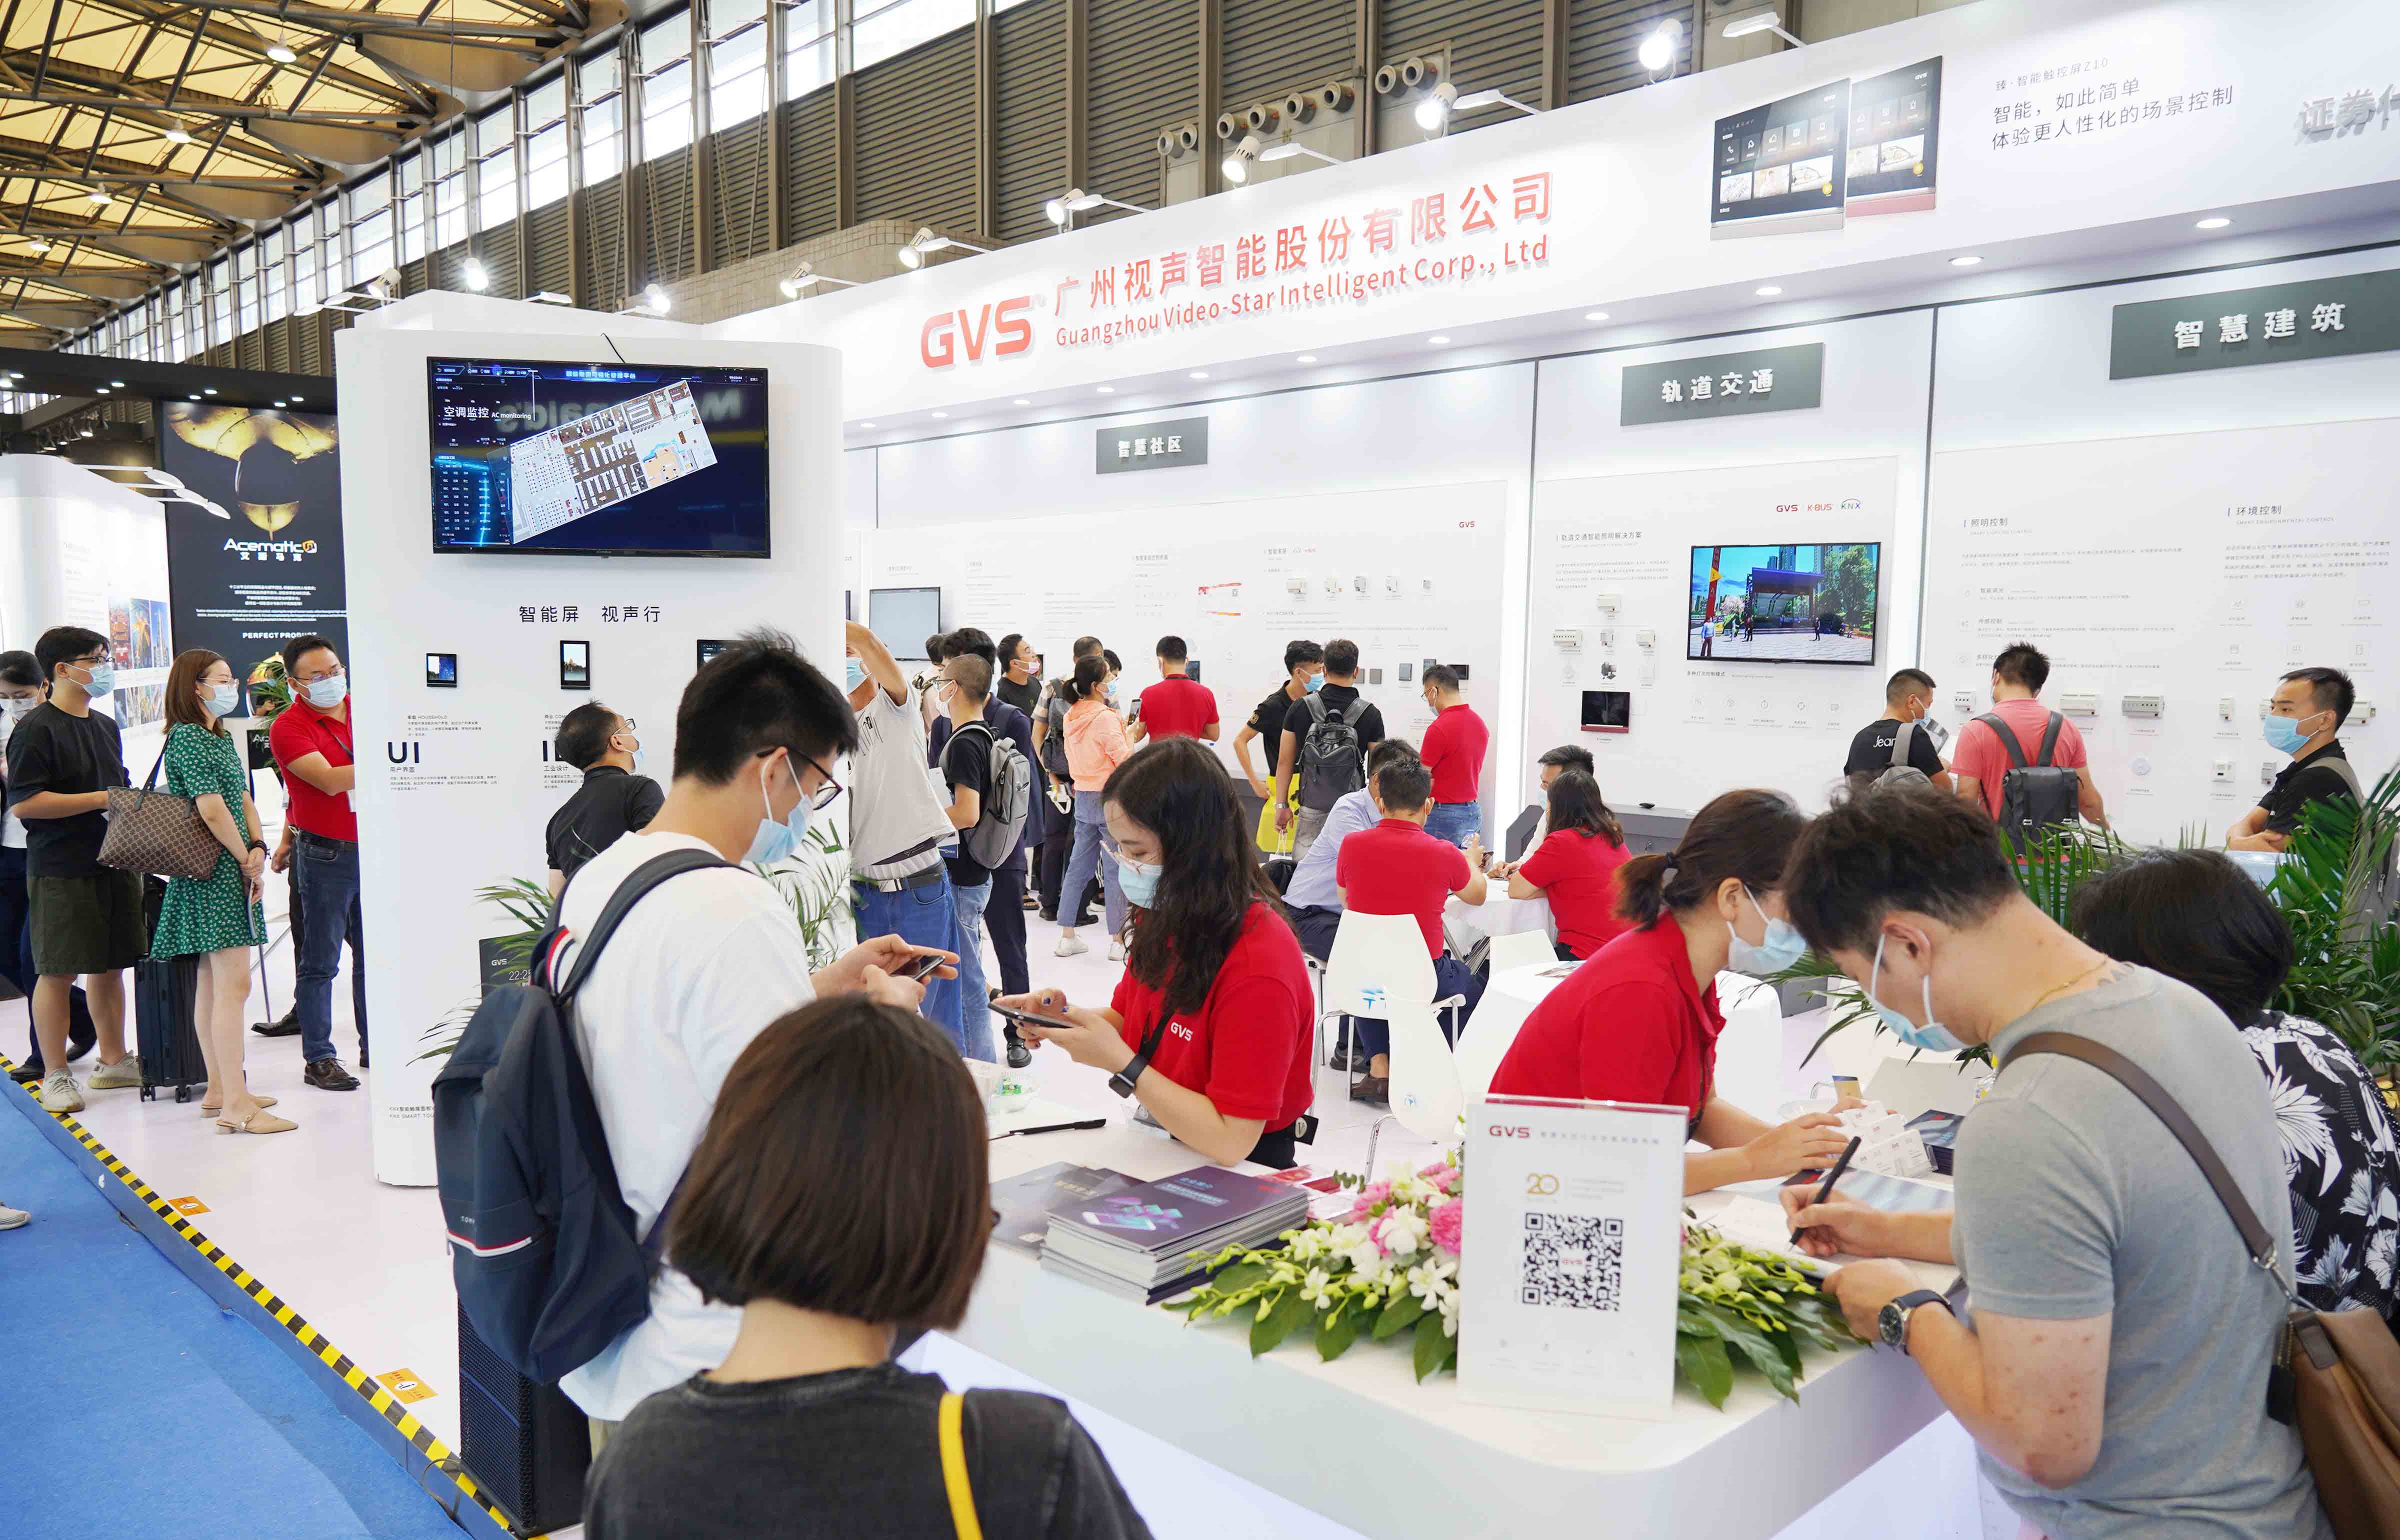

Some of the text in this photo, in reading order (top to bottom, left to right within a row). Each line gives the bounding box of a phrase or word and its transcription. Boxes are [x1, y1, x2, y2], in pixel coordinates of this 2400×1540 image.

[1994, 77, 2140, 124] 智能，如此简单
[1992, 84, 2233, 150] 体验更人性化的场景控制
[1054, 172, 1550, 316] 广州视声智能股份有限公司
[1056, 234, 1547, 346] Guangzhou Video-Star Intelligent Corp., Ltd
[921, 296, 1032, 368] GVS
[2174, 302, 2346, 350] 智慧建筑
[1662, 368, 1774, 402] 轨道交通
[444, 406, 489, 418] 空调监控
[1118, 436, 1182, 458] 智慧社区
[1841, 502, 1860, 510] KNX
[2236, 505, 2282, 516] 环境控制
[1971, 518, 2008, 527] 照明控制
[224, 538, 304, 553] Acematic
[519, 606, 660, 622] 智能屏 视声行
[388, 742, 420, 764] UI
[1170, 1022, 1193, 1042] GVS
[1489, 1125, 1530, 1138] GVS
[1526, 1173, 1560, 1195] 20
